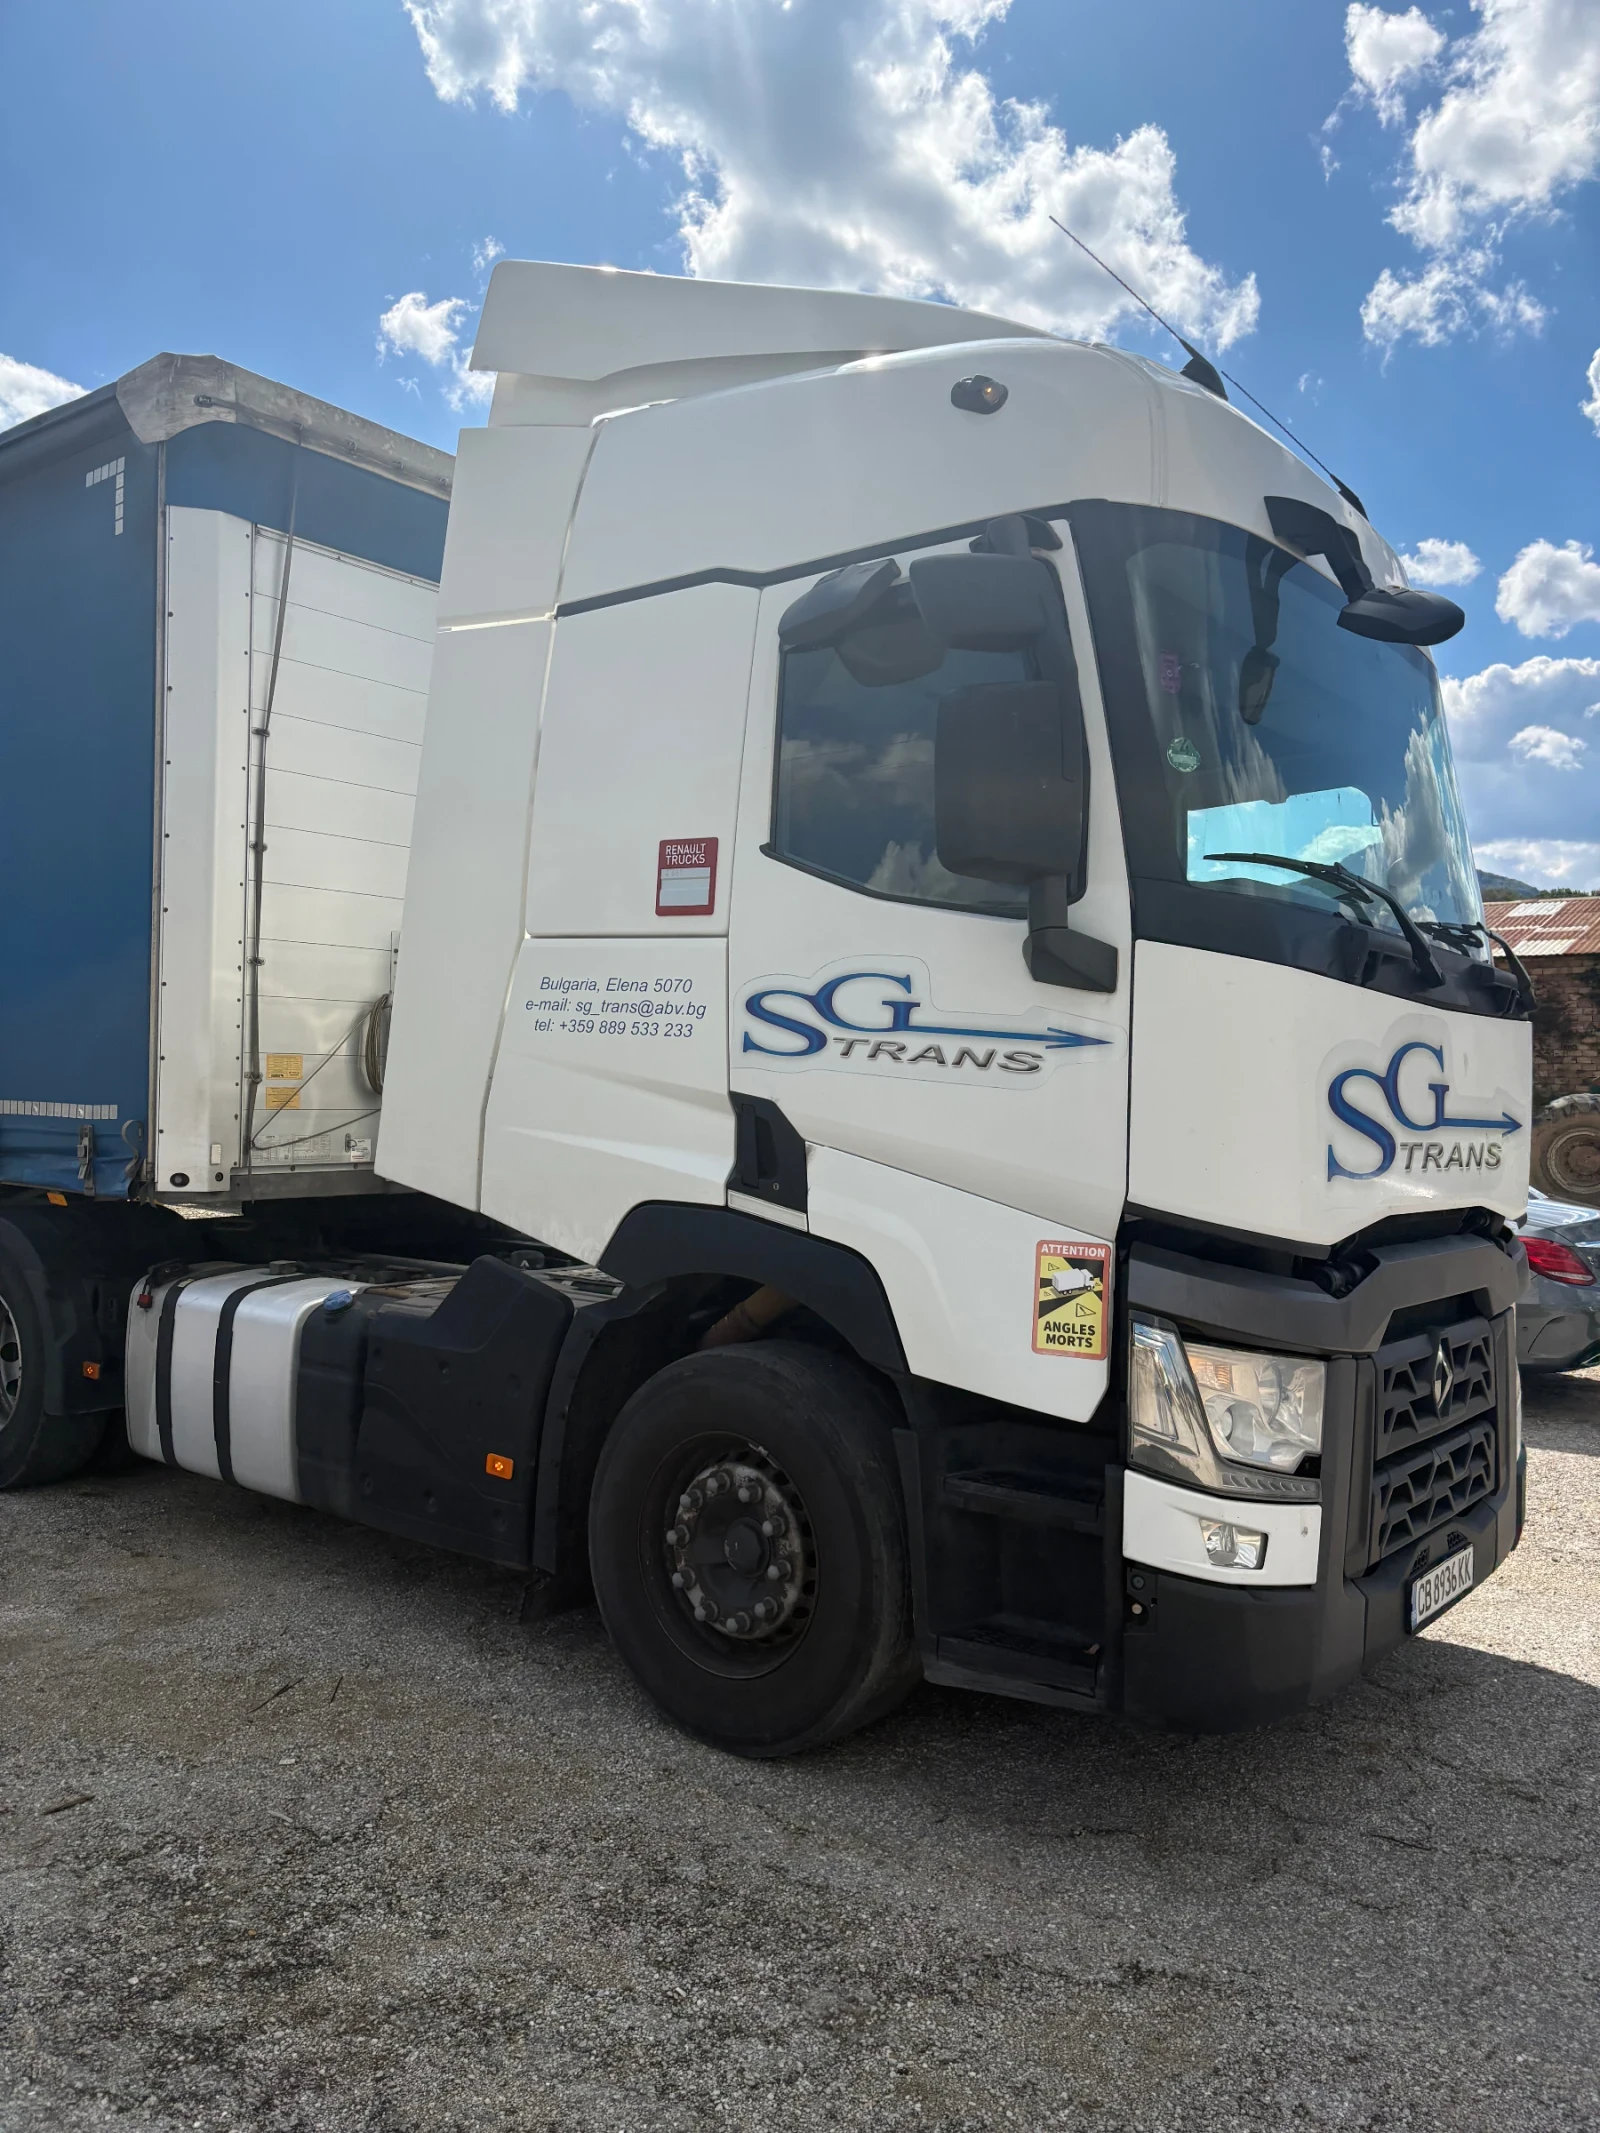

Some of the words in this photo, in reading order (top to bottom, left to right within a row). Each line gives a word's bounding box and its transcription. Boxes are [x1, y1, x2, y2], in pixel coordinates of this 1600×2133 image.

[665, 843, 707, 855] RENAULT
[665, 854, 706, 865] TRUCKS
[539, 976, 600, 994] Bulgaria,
[605, 977, 648, 992] Elena
[653, 978, 693, 993] 5070
[525, 998, 572, 1012] e-mail:
[575, 999, 707, 1020] sg_trans@abv.bg
[743, 972, 921, 1057] SG
[533, 1018, 555, 1033] tel:
[559, 1019, 595, 1034] +359
[598, 1020, 626, 1035] 889
[630, 1021, 659, 1036] 533
[663, 1022, 693, 1038] 233
[832, 1036, 1045, 1074] TRANS
[1327, 1041, 1450, 1183] SG
[1399, 1141, 1503, 1172] TRANS
[1040, 1243, 1106, 1258] ATTENTION
[1043, 1320, 1096, 1336] ANGLES
[1045, 1333, 1093, 1349] MORTS
